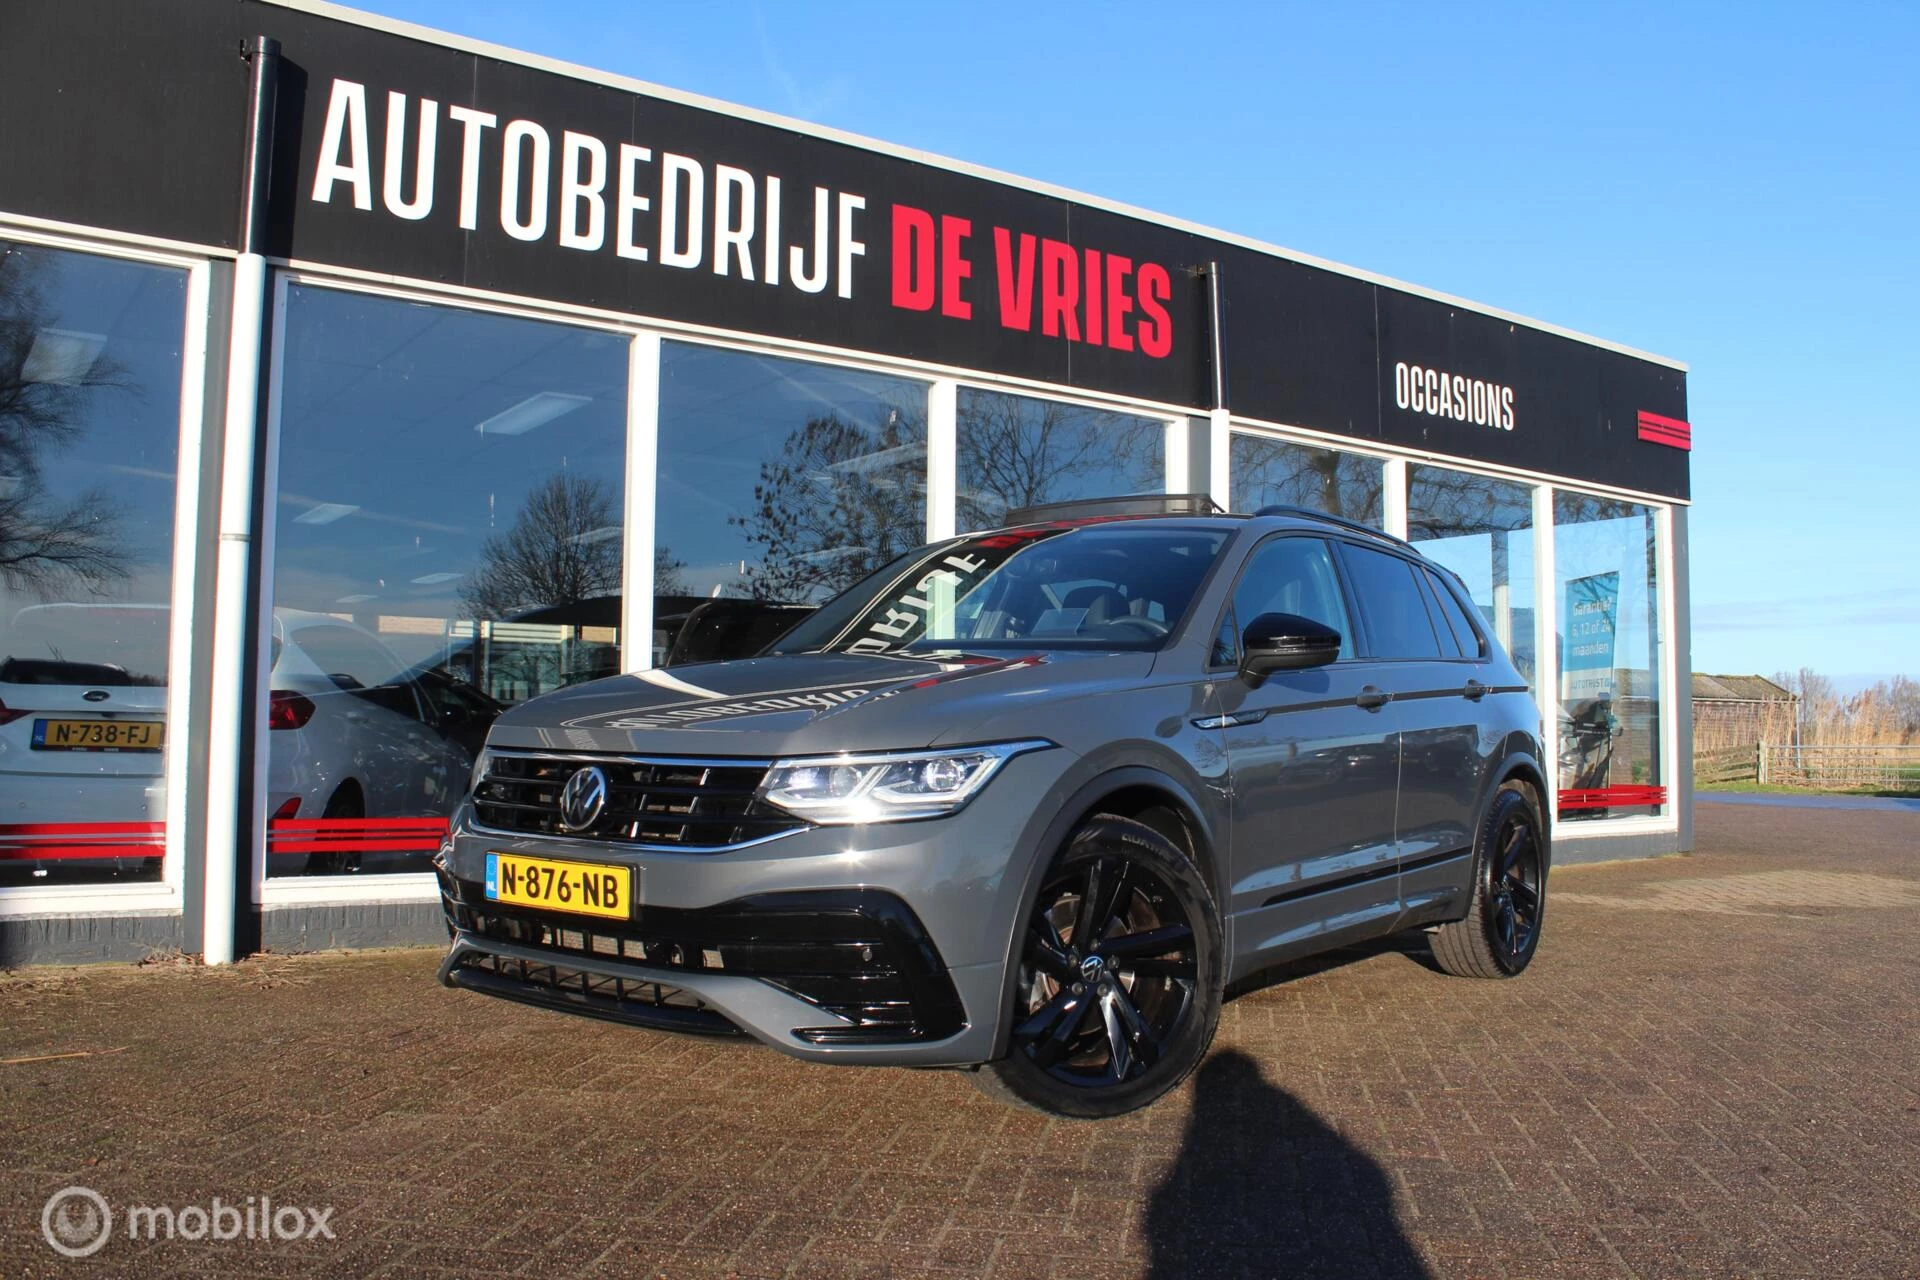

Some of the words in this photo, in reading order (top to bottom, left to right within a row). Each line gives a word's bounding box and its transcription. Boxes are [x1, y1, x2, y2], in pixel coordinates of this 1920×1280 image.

[311, 78, 866, 299] AUTOBEDRIJF
[891, 203, 971, 320] DE
[993, 226, 1173, 359] VRIES
[1395, 362, 1515, 431] OCCASIONS
[55, 724, 151, 744] N-738-FJ
[487, 881, 497, 891] NL
[502, 862, 619, 909] N-876-NB
